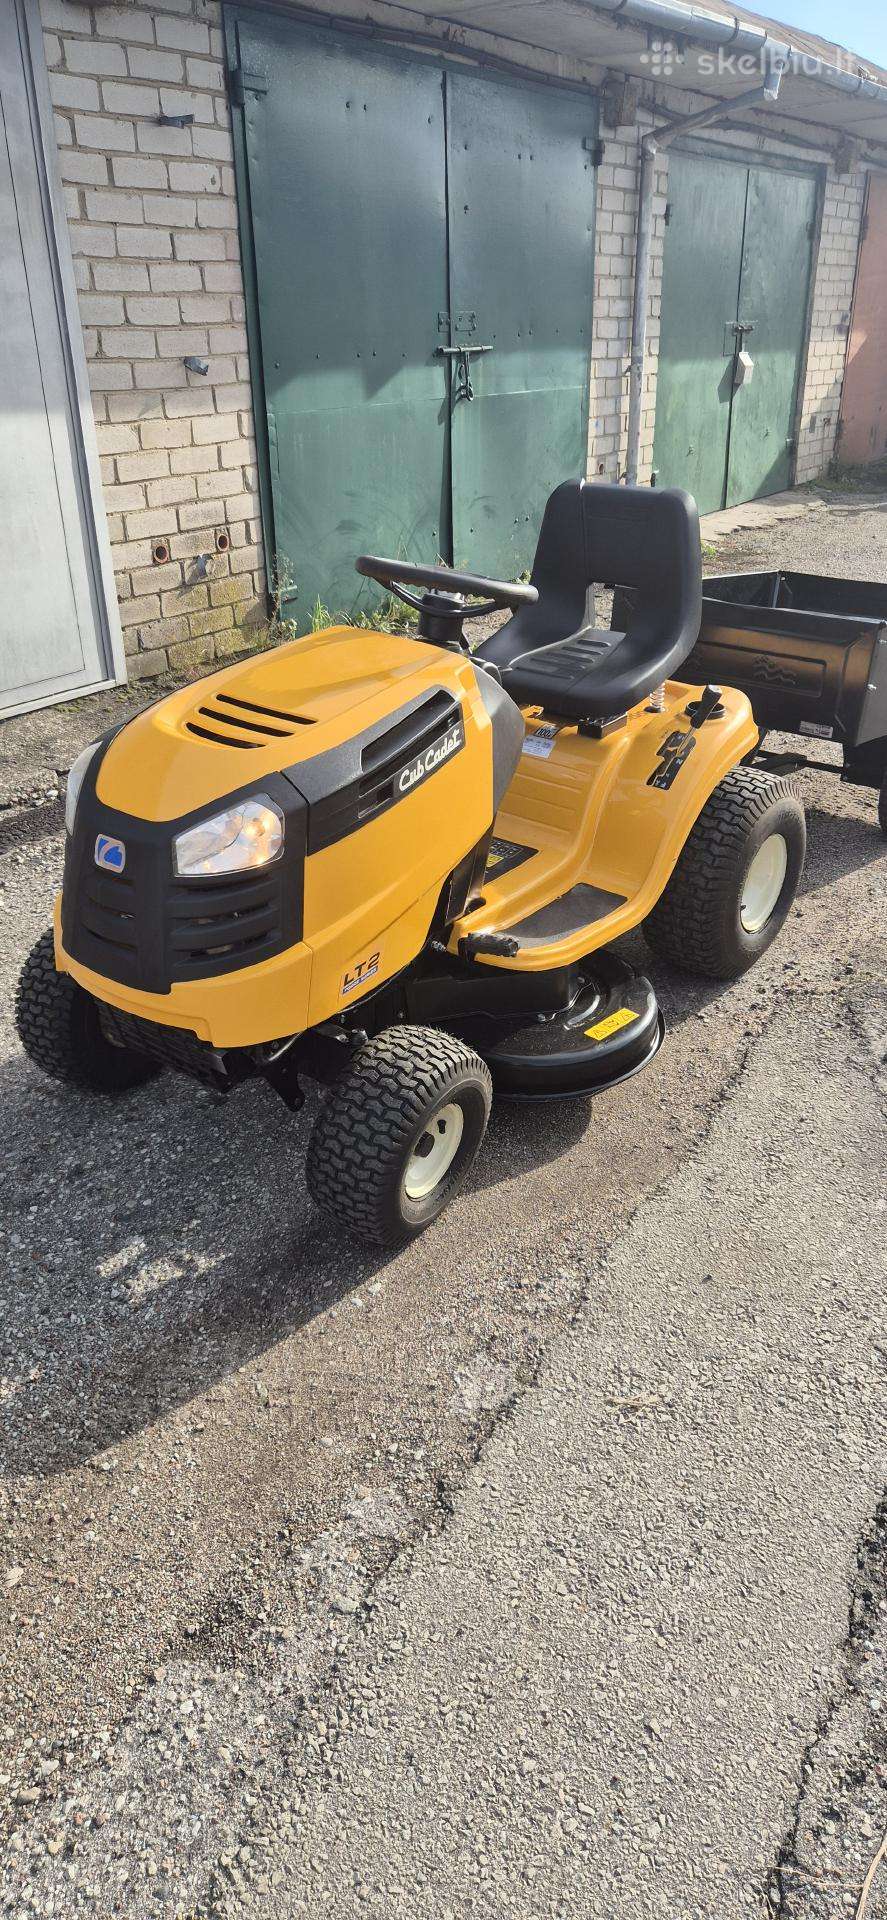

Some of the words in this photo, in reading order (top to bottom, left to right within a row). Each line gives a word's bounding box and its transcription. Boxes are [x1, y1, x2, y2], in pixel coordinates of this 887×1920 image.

[398, 759, 425, 792] Cub
[424, 728, 463, 771] Cadet
[343, 951, 381, 987] LT2
